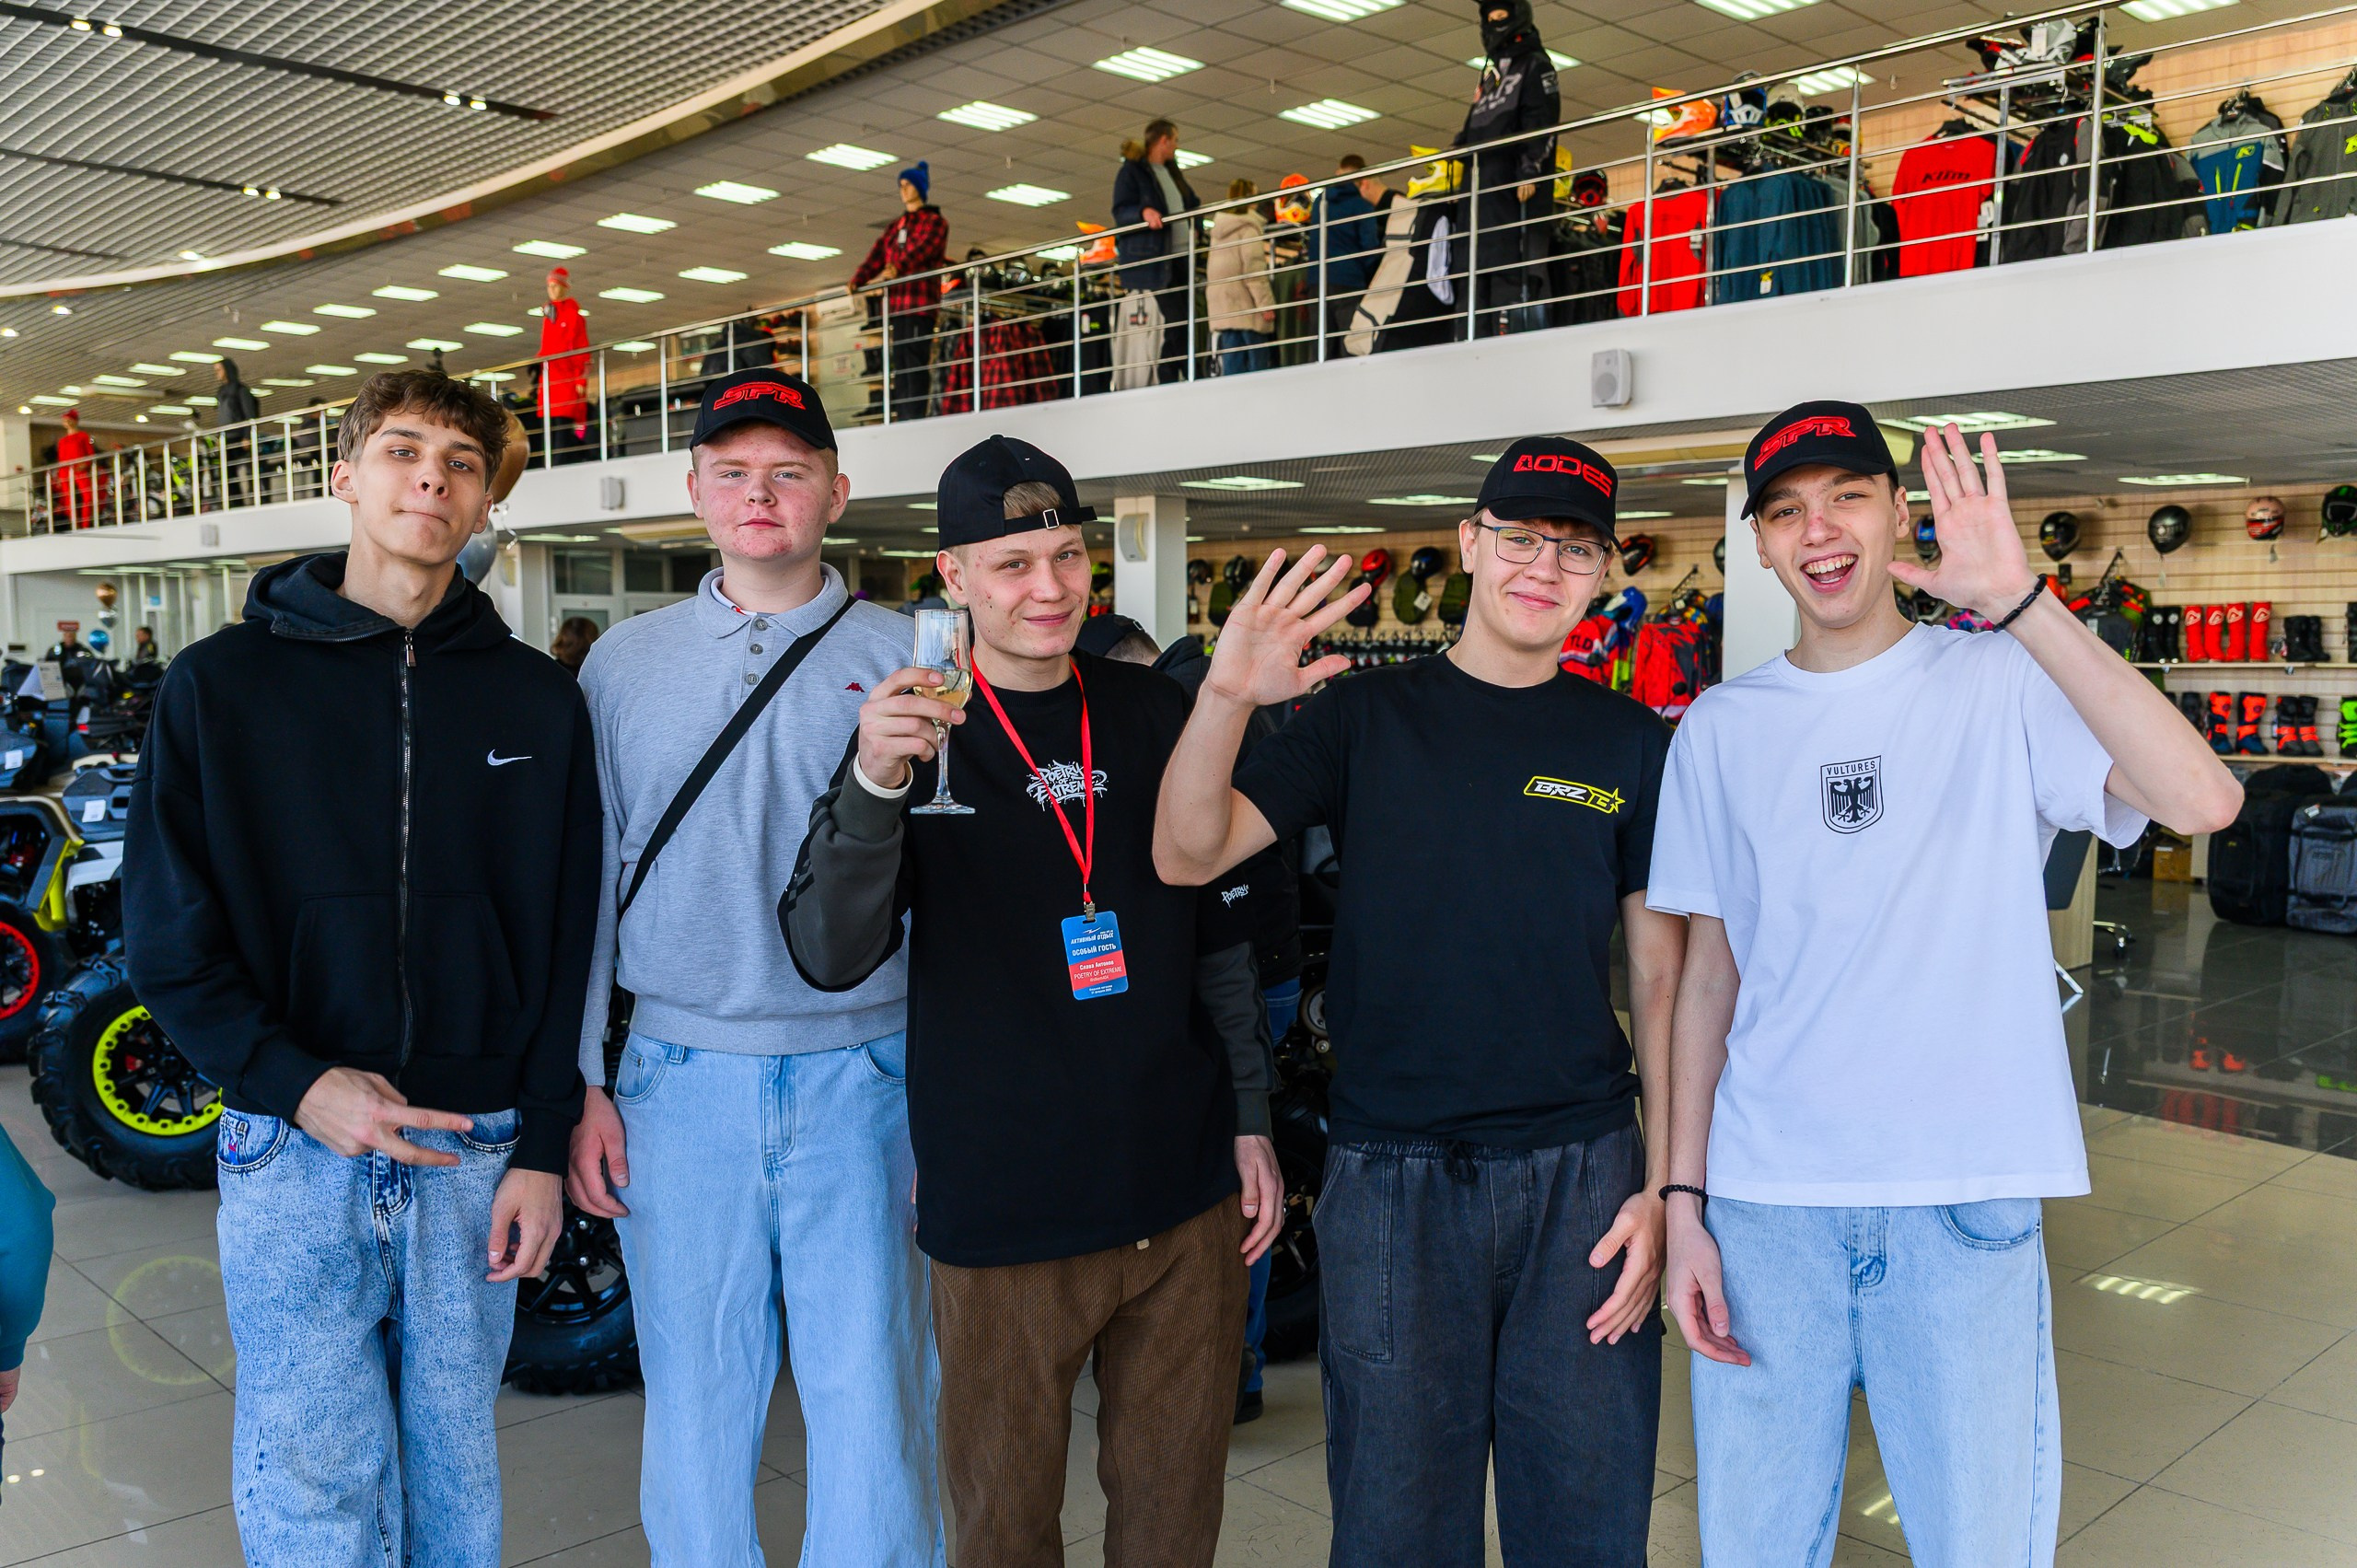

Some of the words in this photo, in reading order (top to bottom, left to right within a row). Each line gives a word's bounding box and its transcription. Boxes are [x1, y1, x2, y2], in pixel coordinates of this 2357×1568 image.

[713, 381, 807, 411] SPR
[1754, 415, 1857, 471] SPR
[1513, 454, 1613, 498] AODES
[1827, 761, 1875, 775] VULTURES
[1534, 780, 1587, 801] BRZ
[1221, 884, 1248, 908] POETRY
[1071, 935, 1097, 945] АКТИВНЫЙ
[1097, 932, 1114, 940] ОТДЫХ
[1072, 946, 1097, 957] ОСОБЫЙ
[1097, 943, 1117, 952] ГОСТЬ
[1074, 970, 1093, 980] POETRY
[1100, 966, 1122, 975] EXTREME
[1079, 962, 1095, 970] Слава
